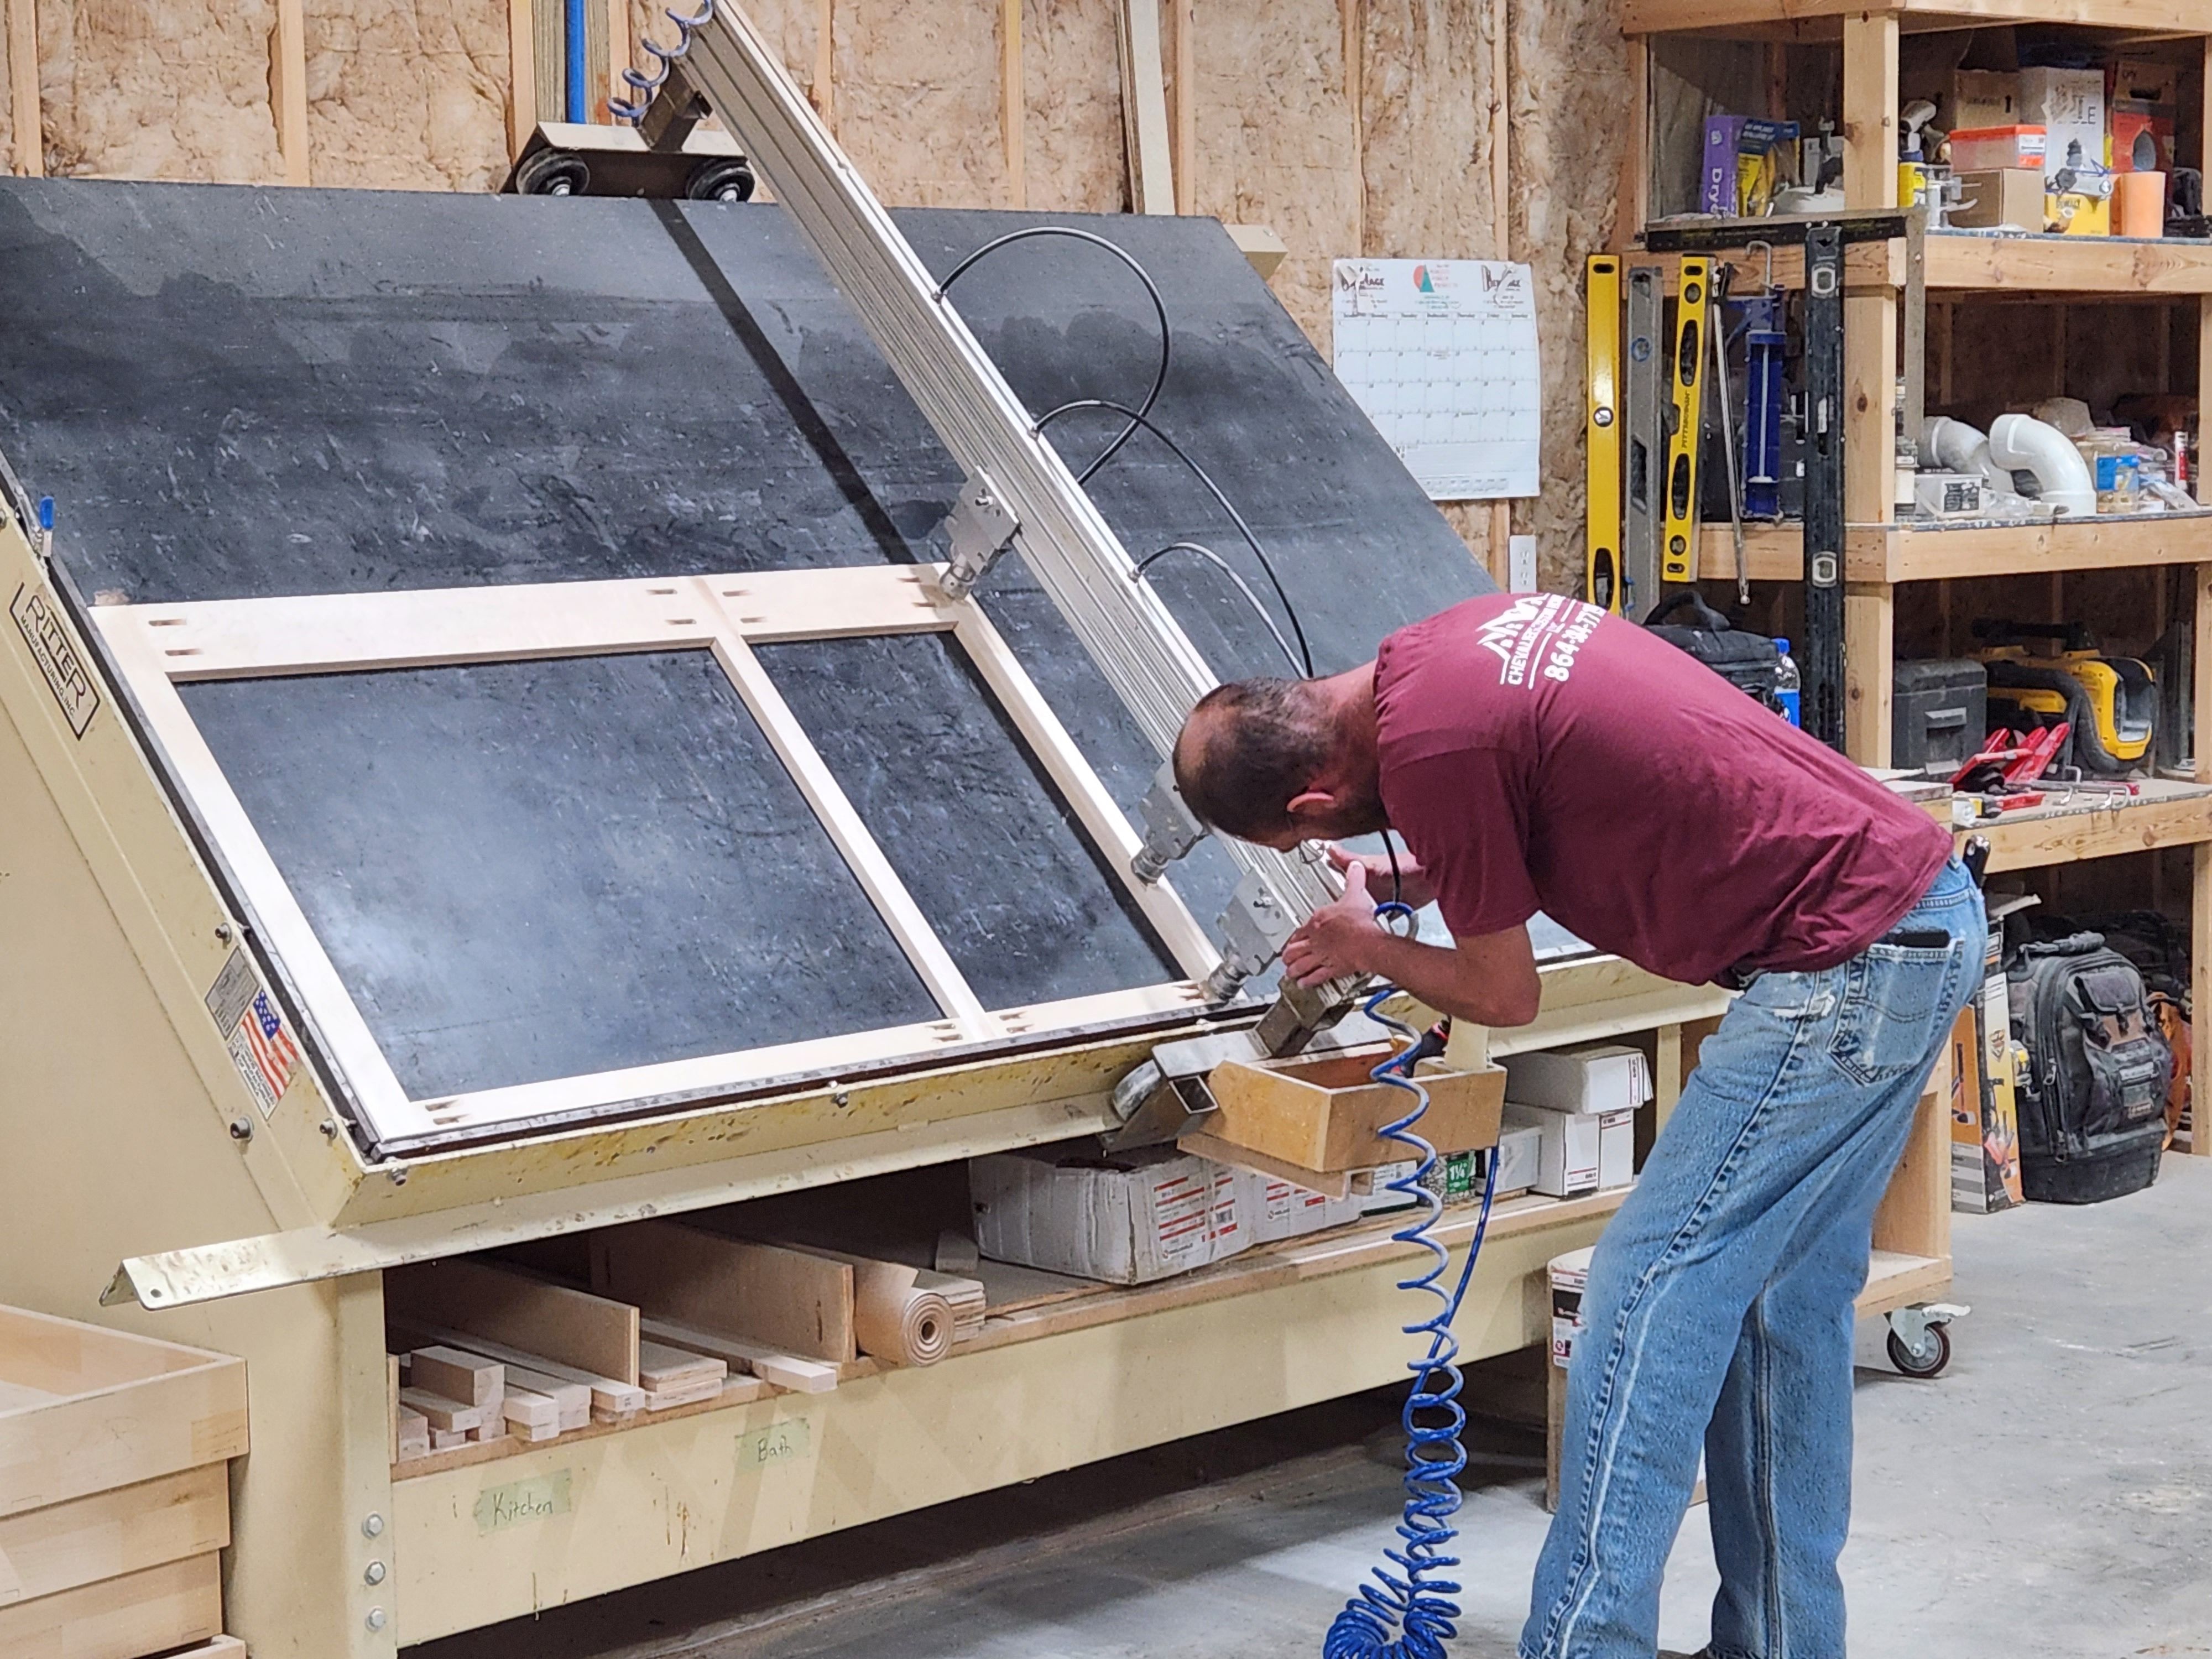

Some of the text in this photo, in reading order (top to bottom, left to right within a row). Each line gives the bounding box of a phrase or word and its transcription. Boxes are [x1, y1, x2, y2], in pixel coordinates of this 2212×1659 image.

[20, 615, 75, 719] MANUFACTURING, INC.
[25, 595, 87, 708] RITTER
[758, 1434, 792, 1463] Bath
[493, 1492, 553, 1526] Kitchen
